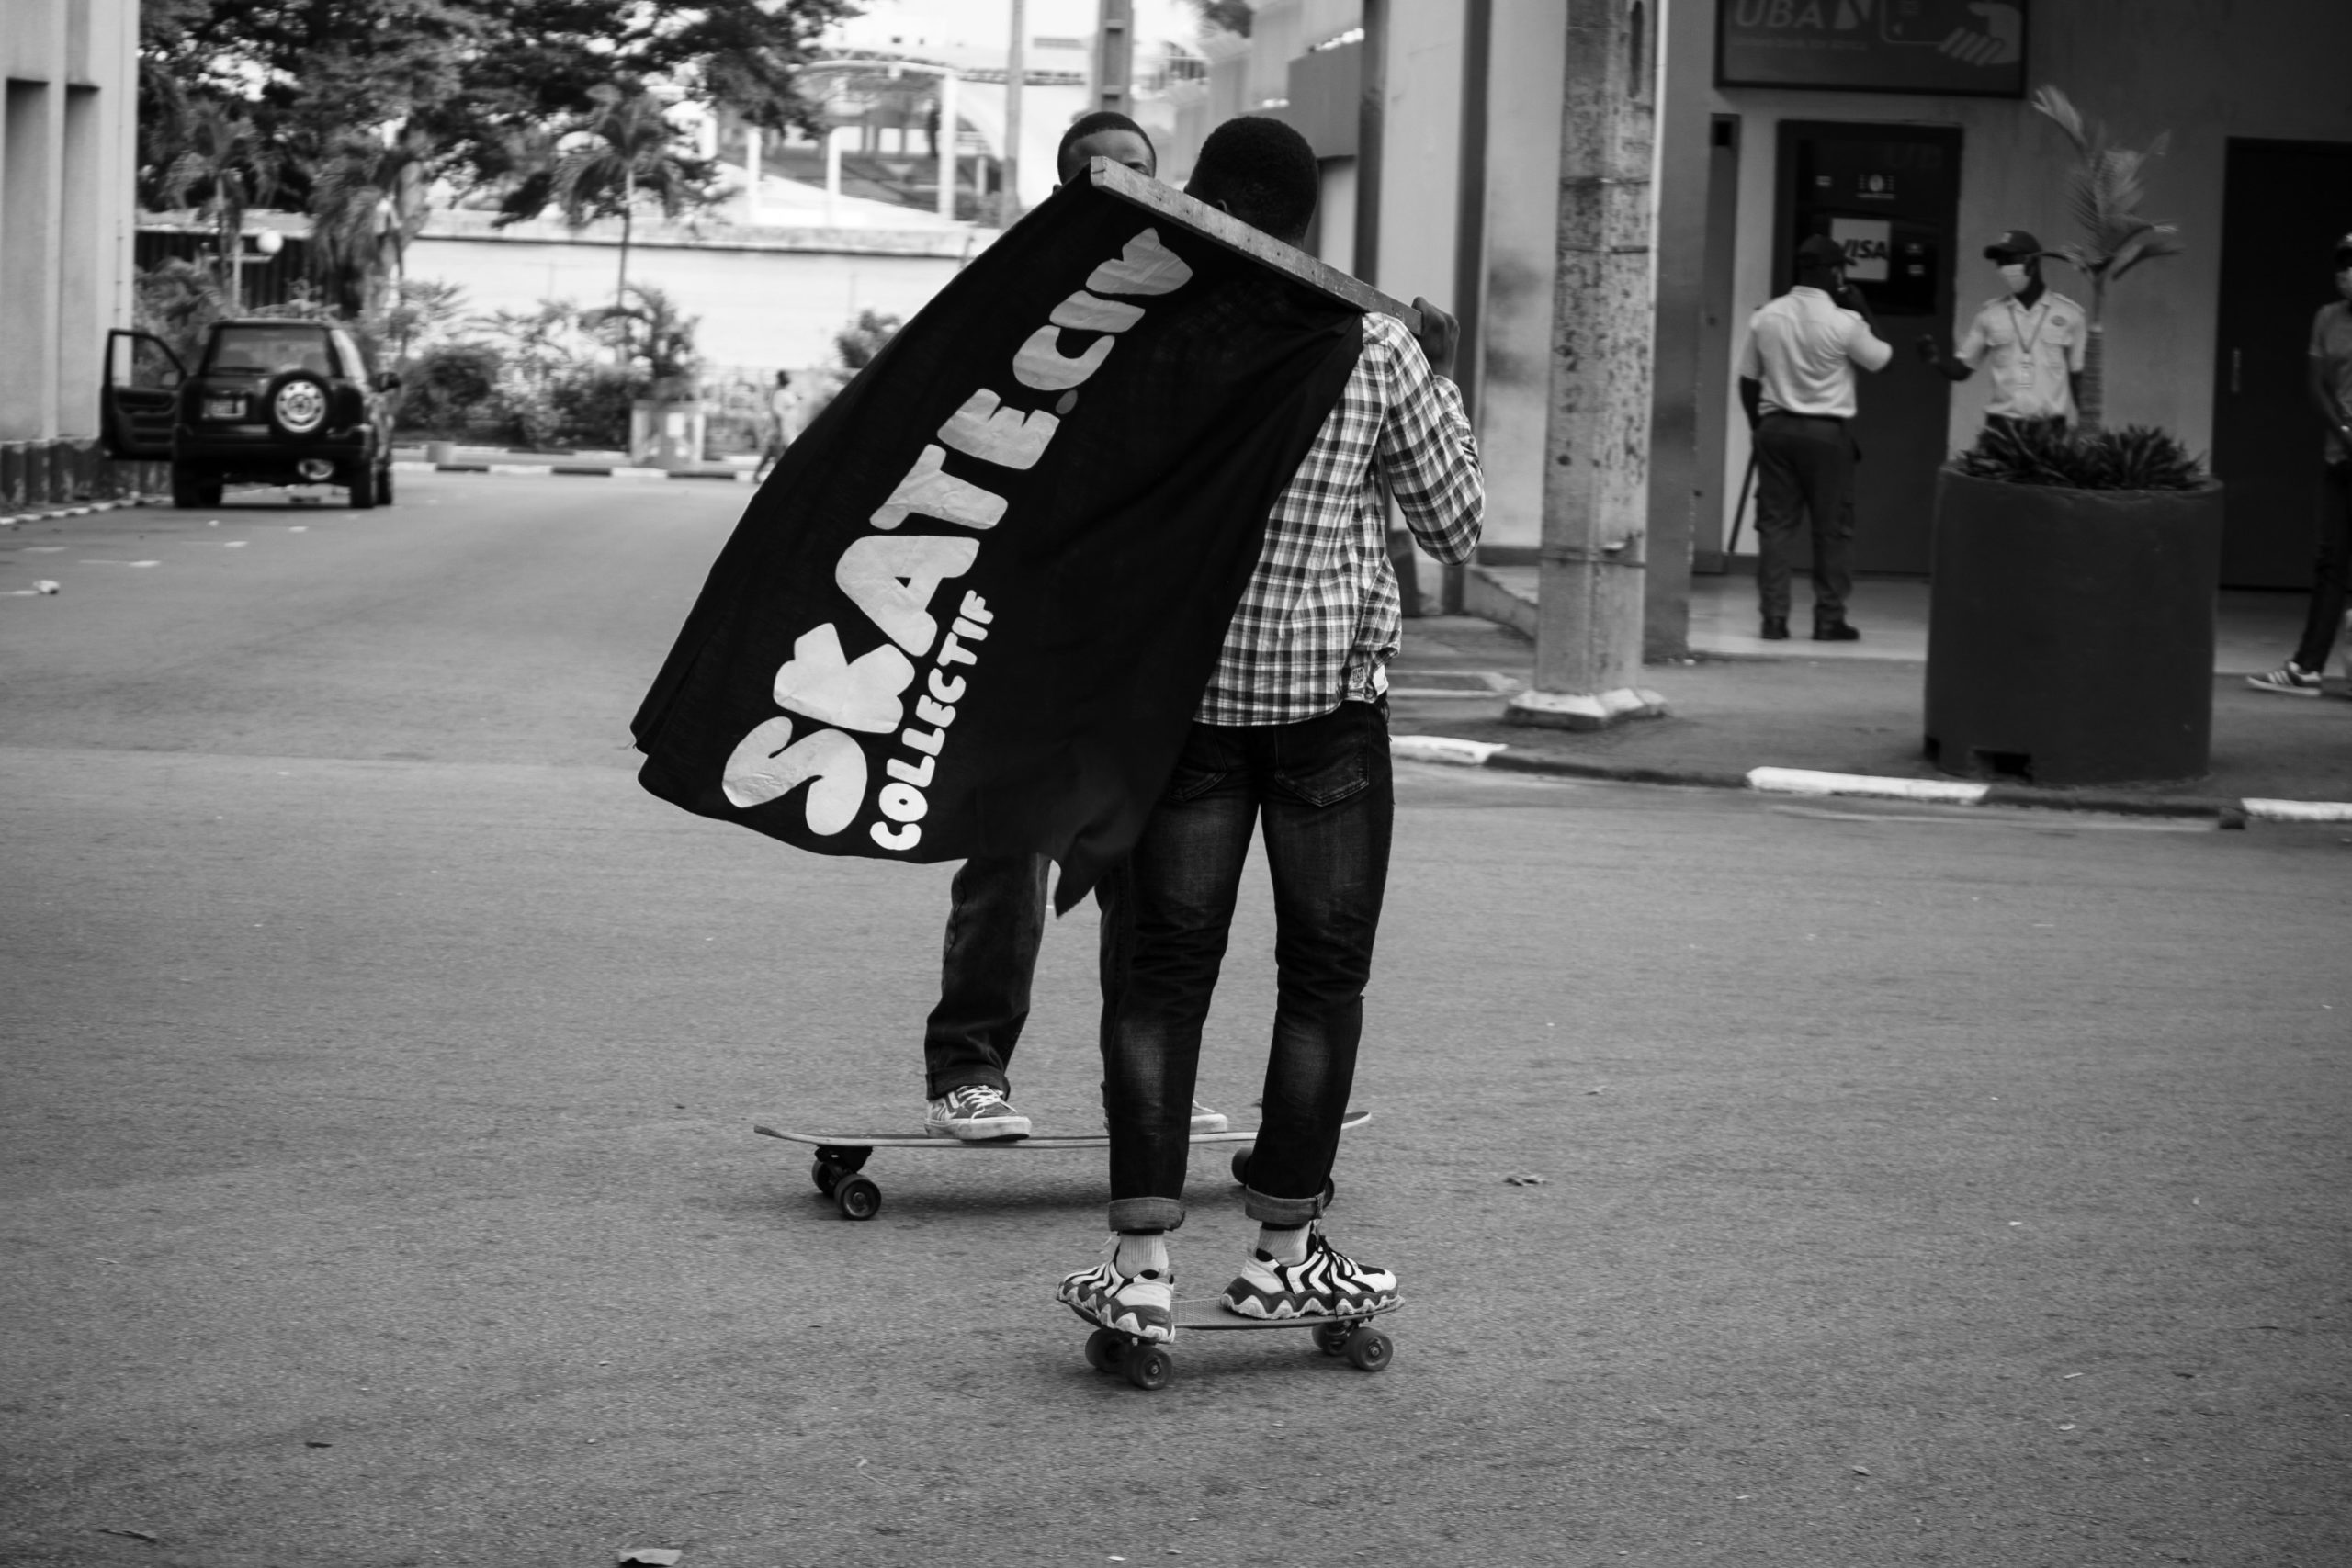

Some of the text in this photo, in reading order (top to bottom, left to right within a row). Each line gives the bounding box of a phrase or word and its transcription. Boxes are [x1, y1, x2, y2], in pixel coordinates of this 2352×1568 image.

[1734, 0, 1825, 28] UBA
[721, 228, 1194, 838] SKATE.CIV
[869, 589, 995, 852] COLLECTIF
